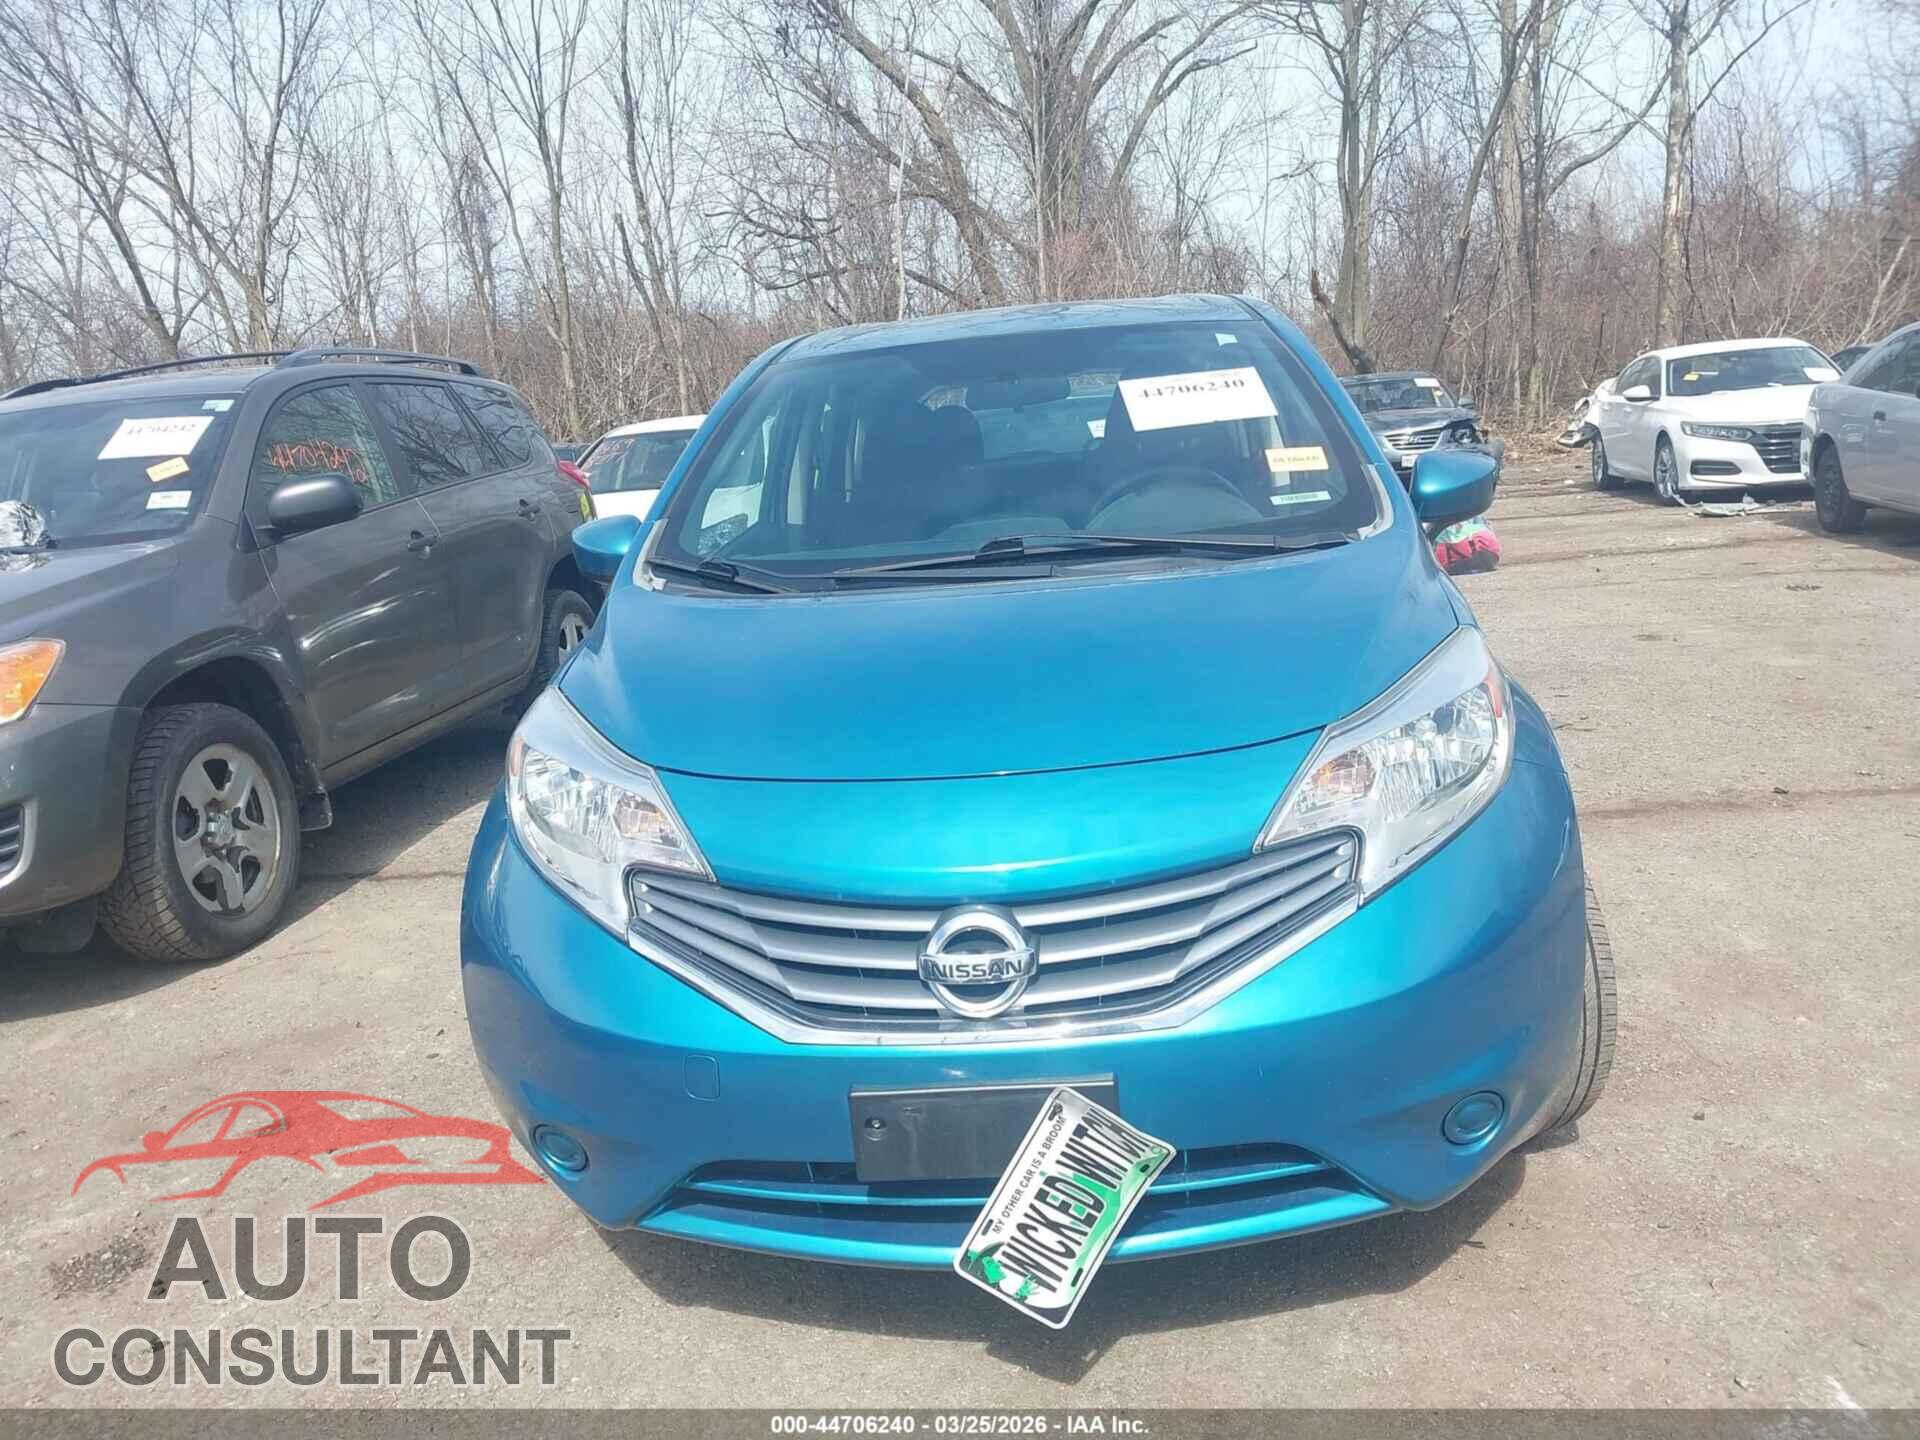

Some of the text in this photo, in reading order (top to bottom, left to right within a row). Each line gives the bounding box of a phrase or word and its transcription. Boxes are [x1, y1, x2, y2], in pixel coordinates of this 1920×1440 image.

[1138, 379, 1246, 398] 44706240
[930, 957, 1023, 979] NISSAN
[992, 1218, 1005, 1234] MY
[1001, 1188, 1024, 1218] OTHER
[1019, 1169, 1036, 1188] CAR
[1031, 1158, 1042, 1168] IS
[1042, 1115, 1066, 1150] BROOM
[998, 1107, 1151, 1293] WICKED WITCH
